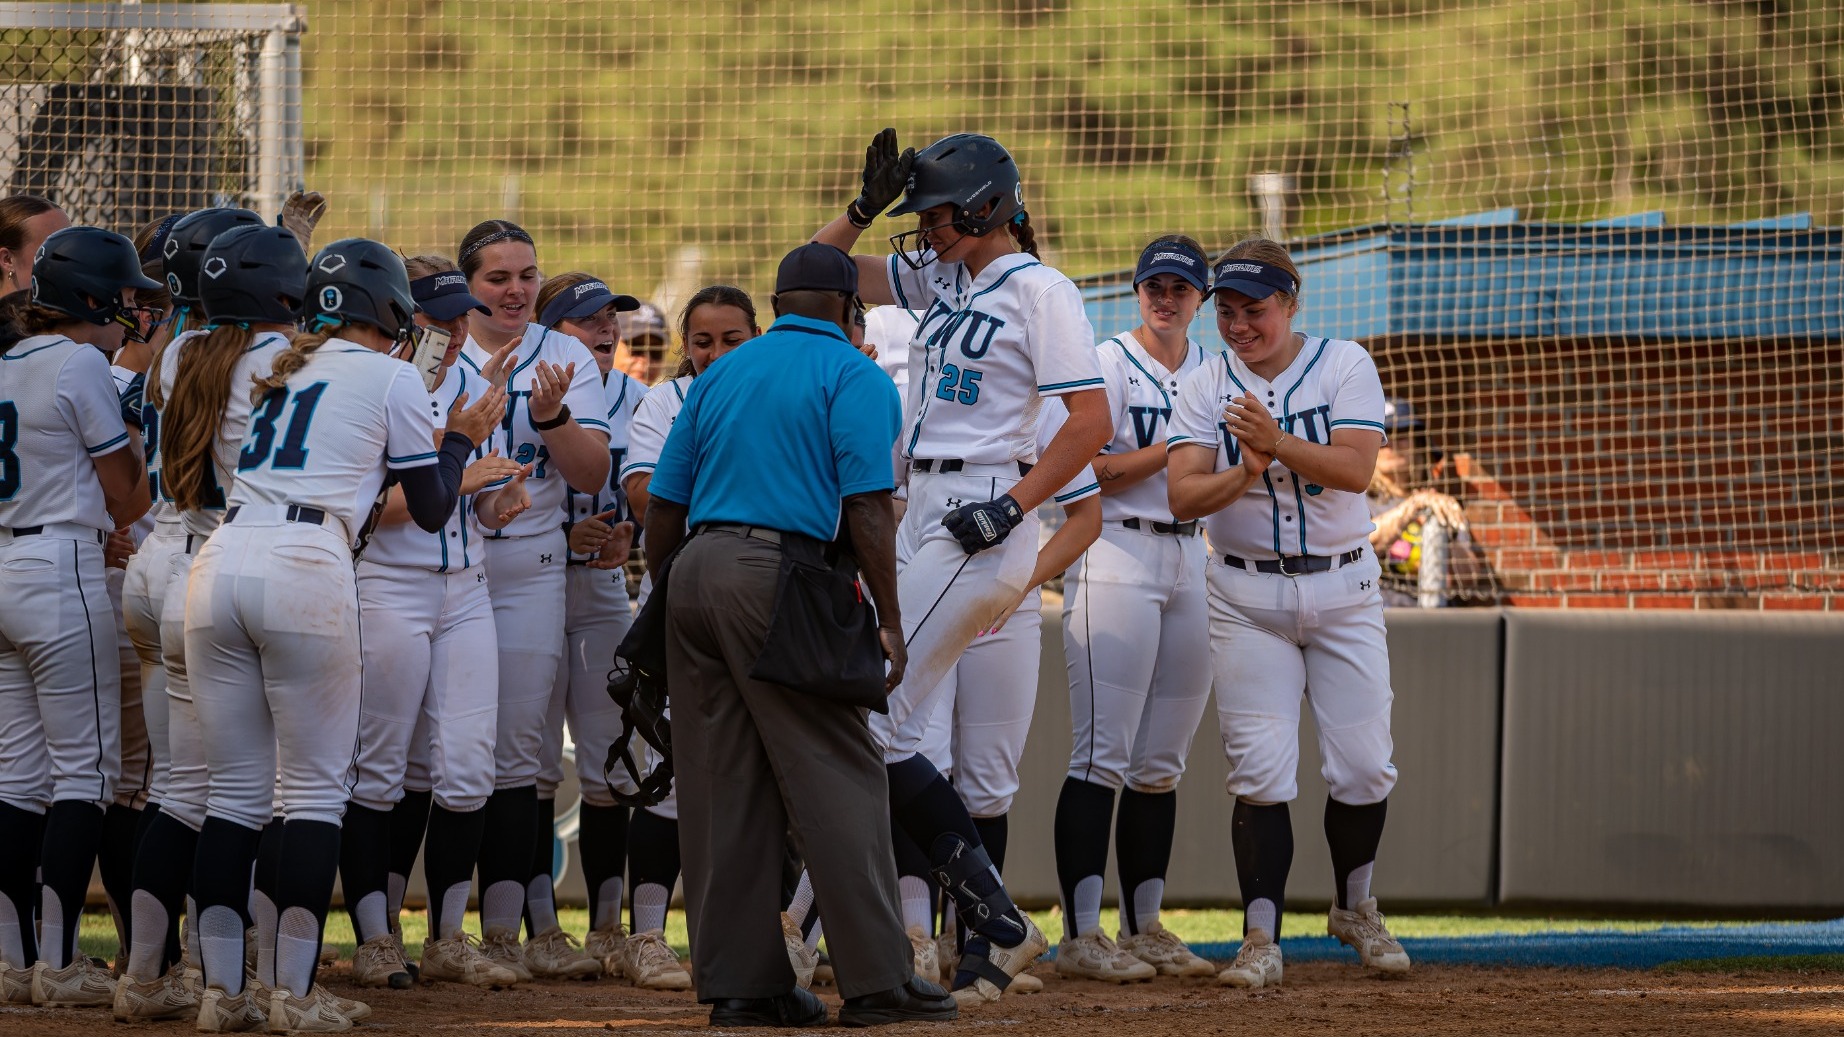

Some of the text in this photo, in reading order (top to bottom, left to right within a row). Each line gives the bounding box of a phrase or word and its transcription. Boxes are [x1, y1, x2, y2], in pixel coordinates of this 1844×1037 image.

[915, 296, 1006, 360] VWU
[935, 363, 983, 406] 25
[238, 381, 330, 475] 31
[514, 442, 551, 479] 27
